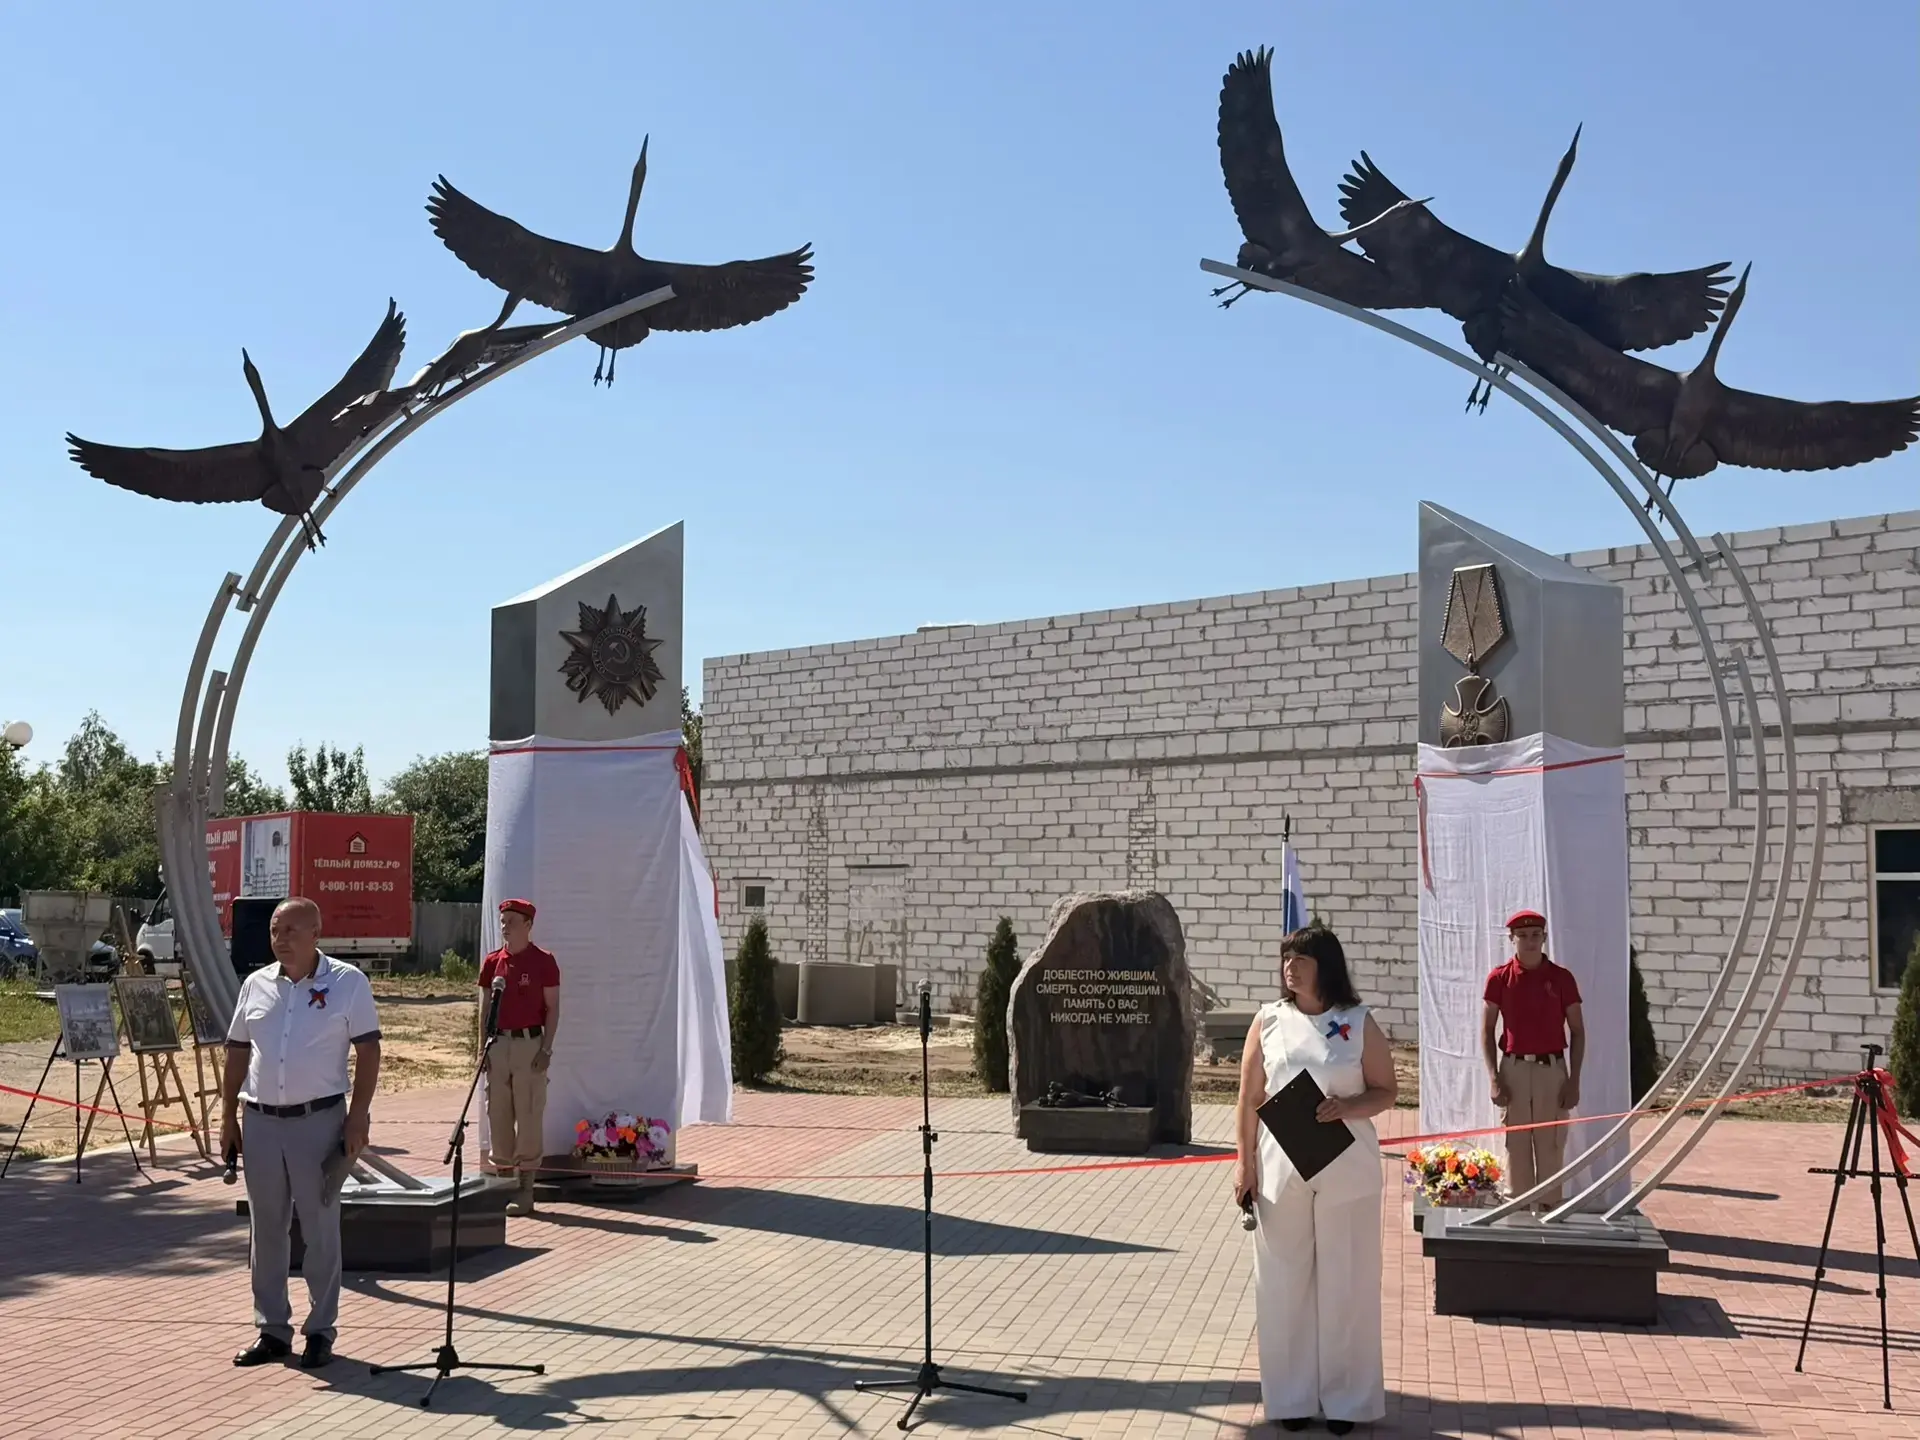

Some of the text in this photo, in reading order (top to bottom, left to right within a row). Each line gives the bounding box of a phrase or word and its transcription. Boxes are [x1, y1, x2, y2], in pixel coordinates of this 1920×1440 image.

[313, 857, 401, 870] ТЁПЛЫЙ ДОМ32.РФ
[319, 880, 394, 892] 8-800-101-83-53
[1043, 969, 1158, 983] ДОБЛЕСТНО ЖИВШИМ,
[1036, 983, 1077, 995] СМЕРТЬ
[1063, 998, 1139, 1010] ПАМЯТЬ О ВАС
[1050, 1011, 1152, 1025] НИКОГДА НЕ УМРЁТ.
